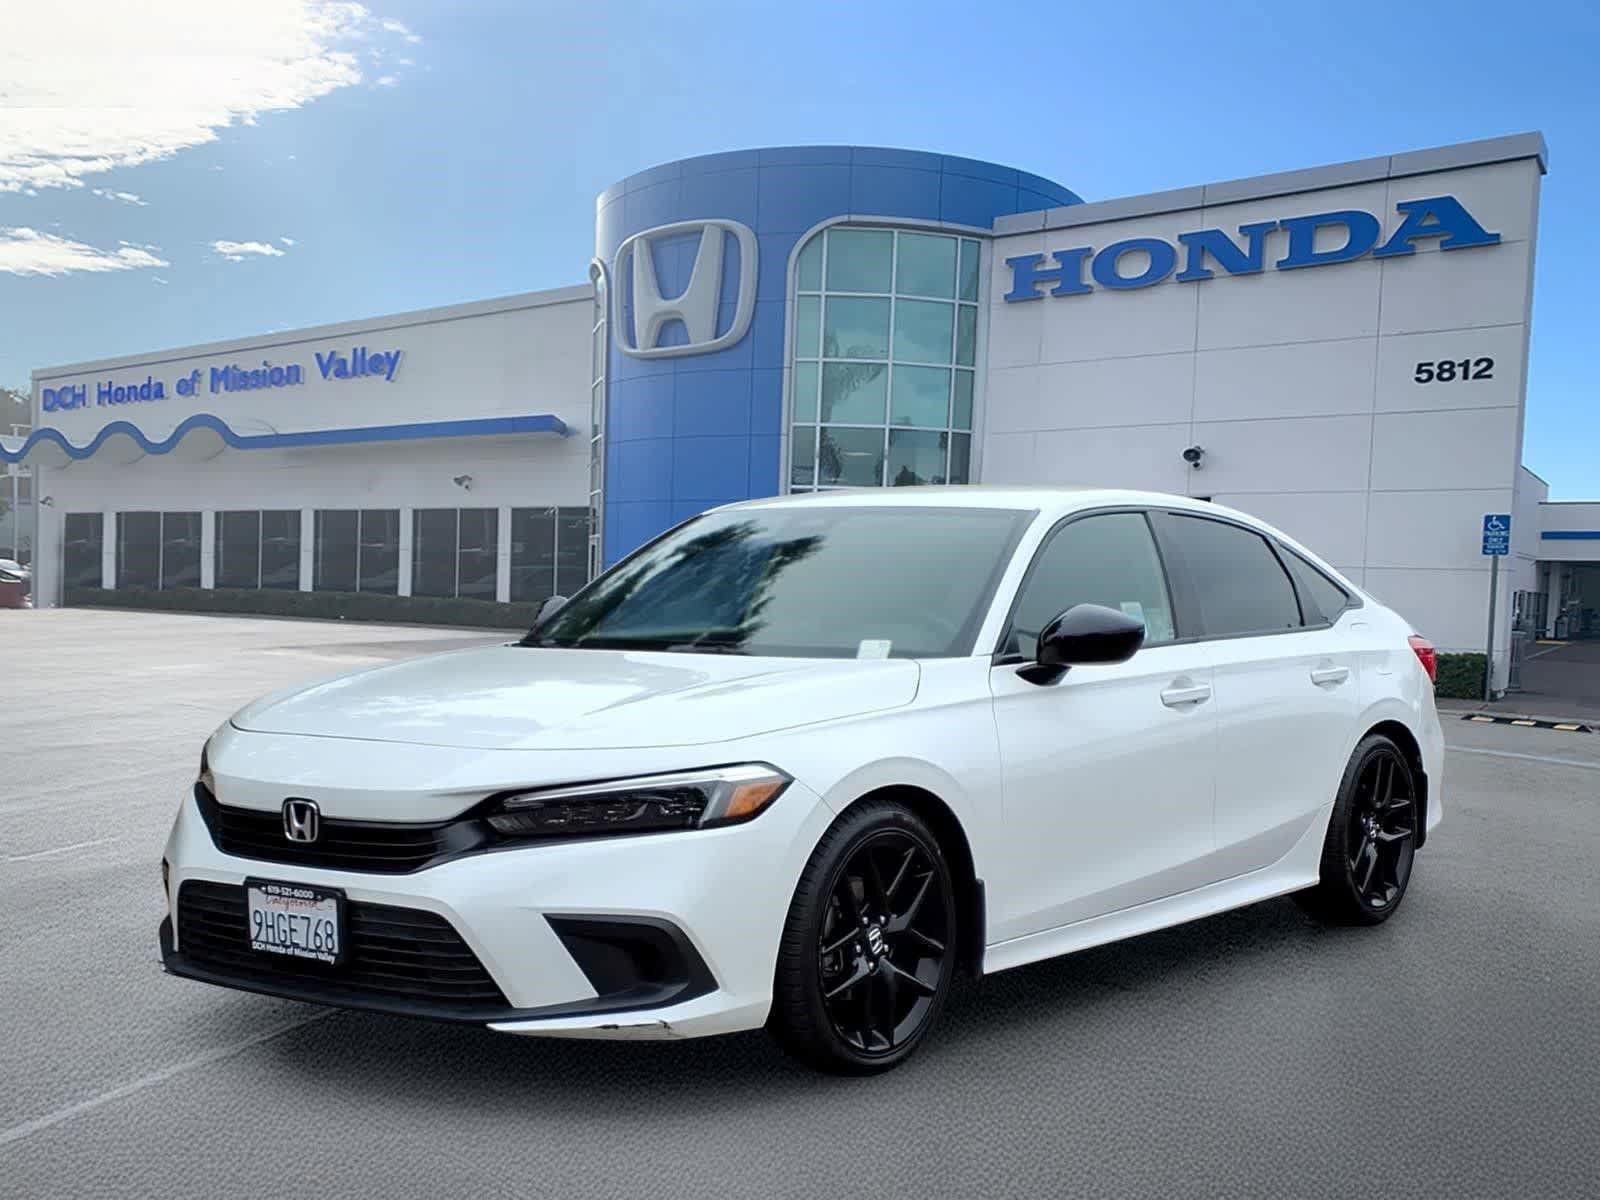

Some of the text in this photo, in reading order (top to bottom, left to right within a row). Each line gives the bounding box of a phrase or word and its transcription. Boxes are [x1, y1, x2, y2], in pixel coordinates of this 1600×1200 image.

[1004, 195, 1502, 302] HONDA
[42, 346, 402, 412] DCH Honda of Mission Valley
[1414, 356, 1495, 384] 5812
[267, 885, 314, 899] 619-521-6000
[253, 910, 335, 951] 9HGE768
